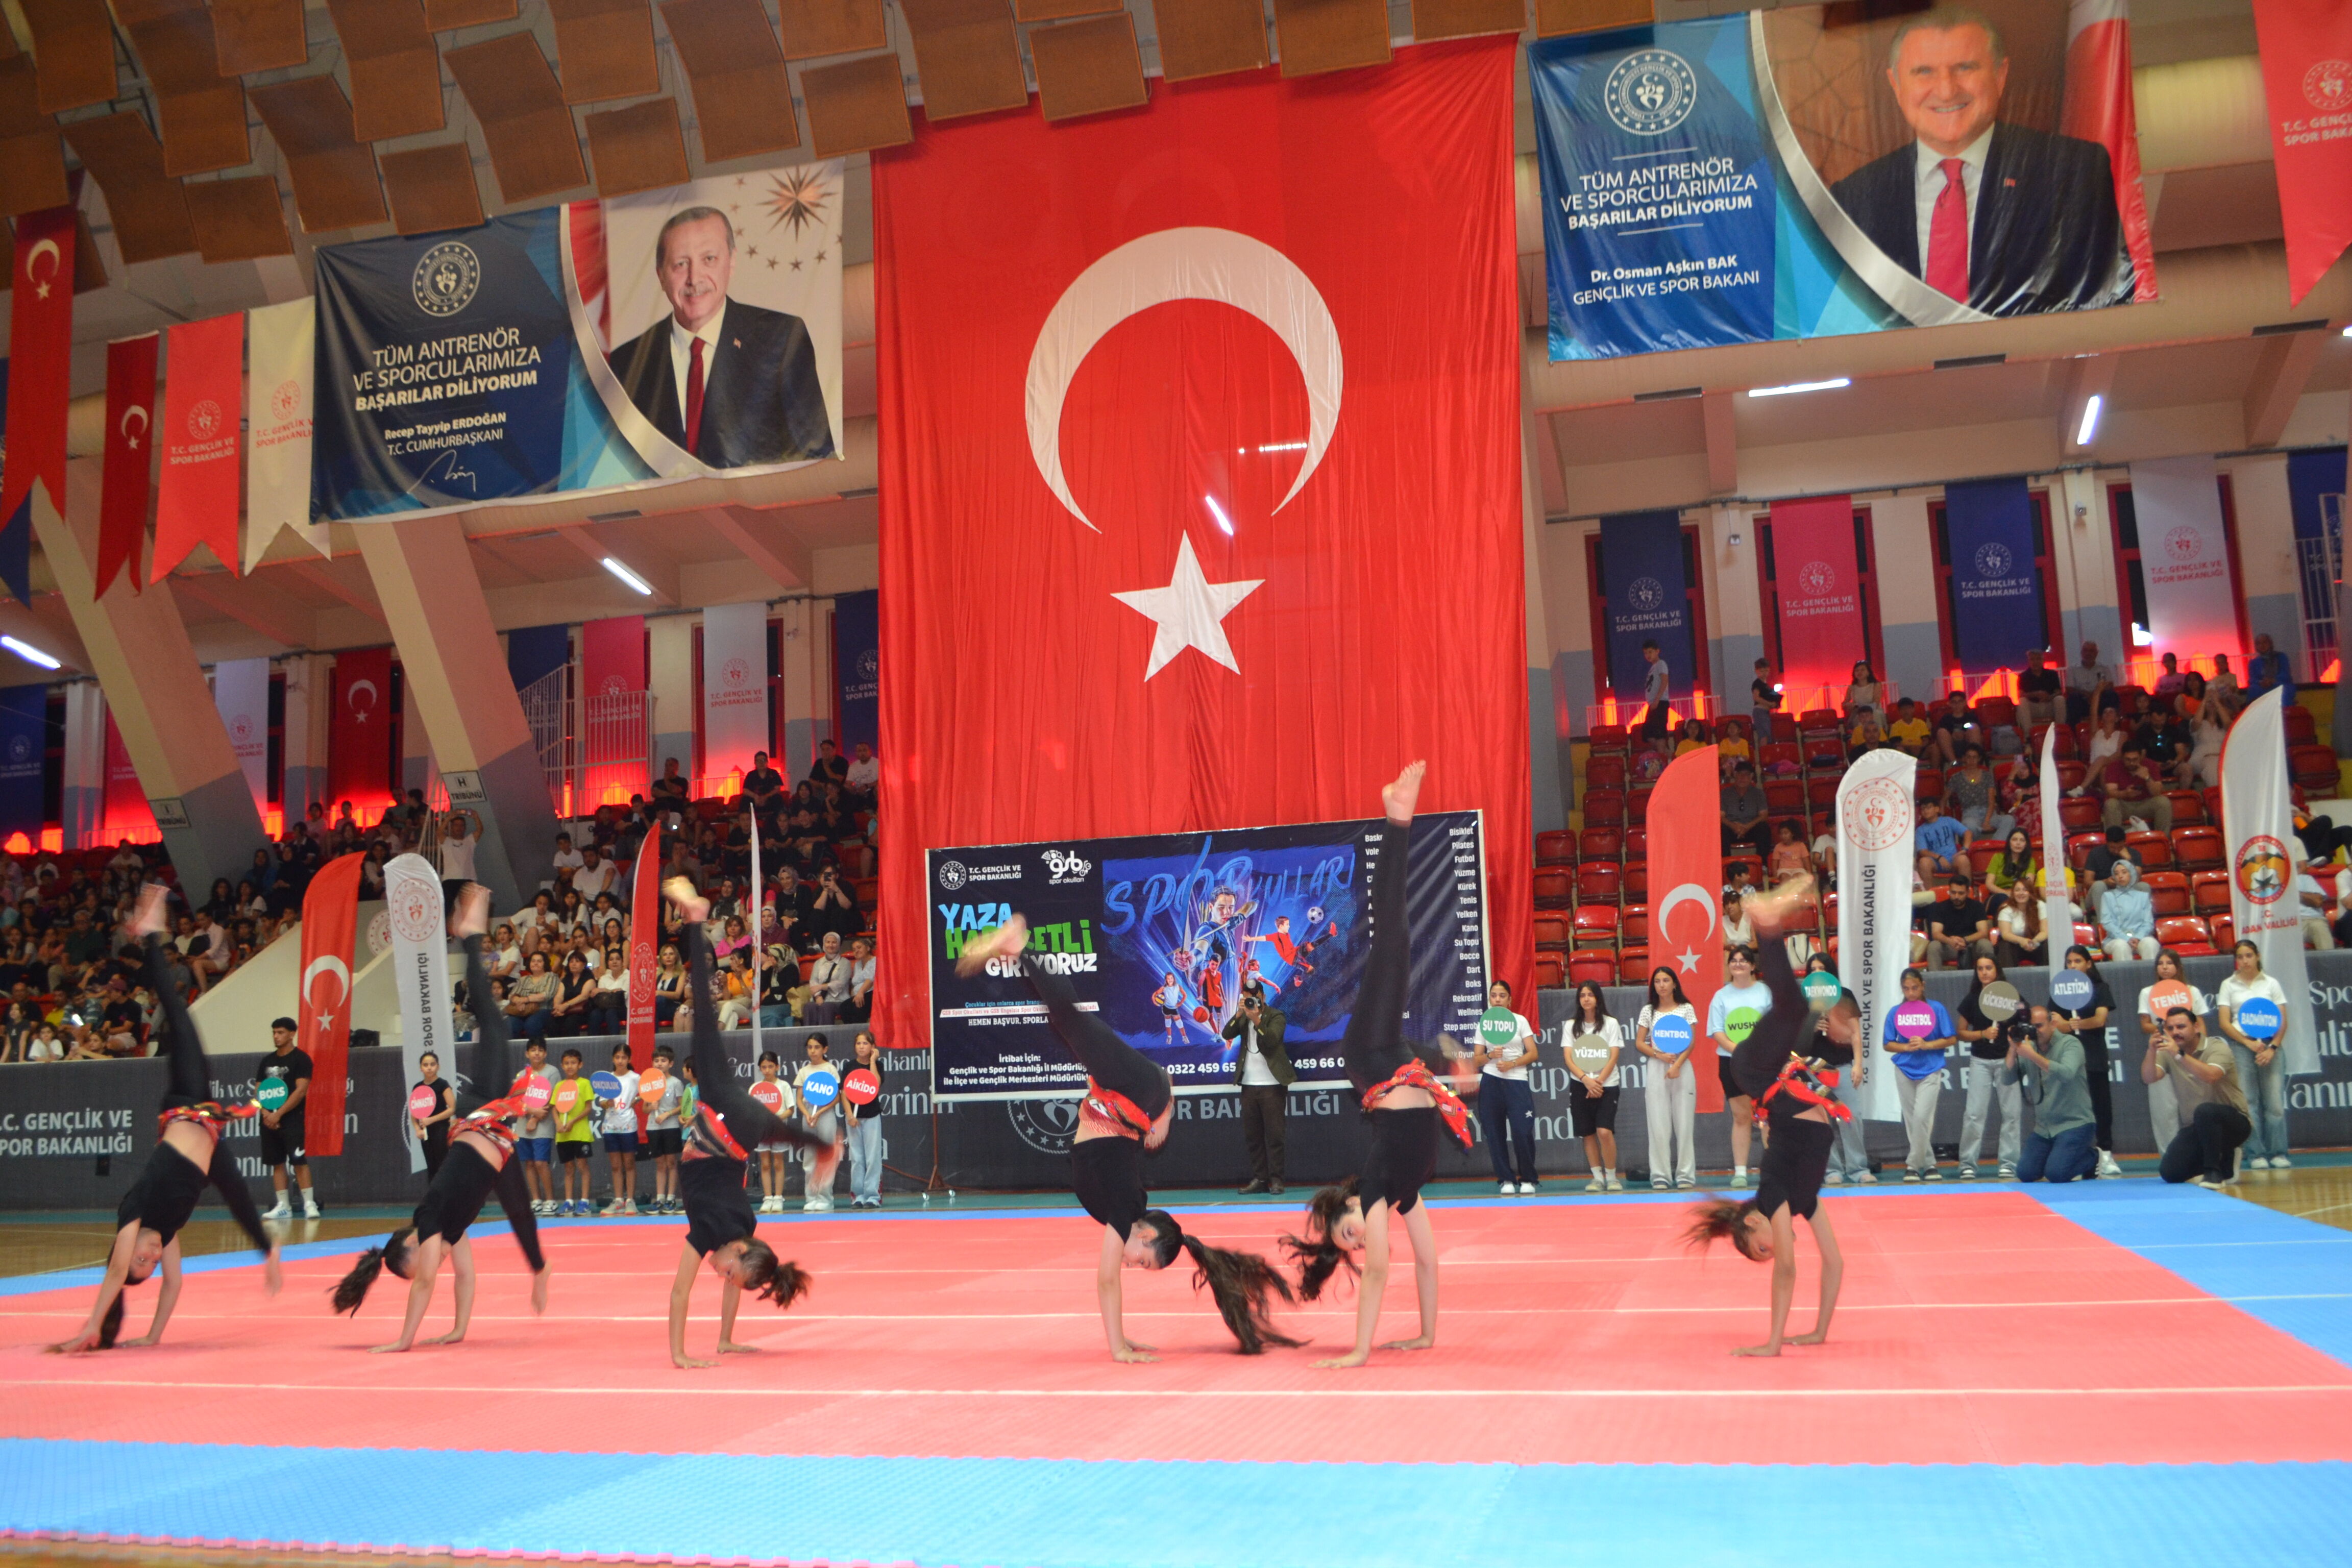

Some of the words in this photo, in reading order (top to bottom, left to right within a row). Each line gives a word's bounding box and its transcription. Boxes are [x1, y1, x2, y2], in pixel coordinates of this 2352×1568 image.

[2284, 131, 2319, 146] SPOR
[1580, 170, 1624, 192] TÜM
[1629, 156, 1734, 186] ANTRENÖR
[1560, 194, 1581, 213] VE
[1588, 174, 1758, 210] SPORCULARIMIZA
[1569, 206, 1658, 230] BAŞARILAR
[1660, 194, 1753, 219] DİLİYORUM
[1591, 269, 1611, 283] Dr.
[1613, 264, 1662, 280] Osman
[1665, 258, 1704, 276] Aşkın
[1707, 255, 1738, 270] BAK
[1573, 282, 1635, 306] GENÇLİK
[1637, 281, 1656, 297] VE
[1659, 277, 1699, 295] SPOR
[1703, 271, 1760, 289] BAKANI
[373, 344, 413, 368] TÜM
[418, 327, 520, 359] ANTRENÖR
[354, 369, 373, 391] VE
[378, 346, 541, 388] SPORCULARIMIZA
[356, 382, 444, 412] BAŞARILAR
[446, 370, 537, 399] DİLİYORUM
[385, 428, 414, 441] Recep
[416, 422, 451, 437] Tayyip
[452, 412, 506, 430] ERDOĞAN
[170, 446, 187, 455] T.C.
[188, 439, 223, 455] GENÇLİK
[224, 437, 235, 447] VE
[387, 444, 405, 456] T.C.
[406, 428, 503, 453] CUMHURBAŞKANI
[170, 454, 193, 465] SPOR
[2169, 562, 2209, 574] GENÇLİK
[2152, 575, 2175, 583] SPOR
[2177, 569, 2223, 581] BAKANLIĞI
[1979, 578, 2016, 590] GENÇLİK
[2019, 577, 2029, 585] VE
[1962, 590, 1984, 598] SPOR
[1986, 586, 2031, 597] BAKANLIĞI
[1803, 597, 1840, 607] GENÇLİK
[1809, 604, 1854, 615] BAKANLIĞI
[1632, 612, 1668, 623] GENÇLİK
[1616, 624, 1637, 632] SPOR
[1639, 619, 1681, 630] BAKANLIĞI
[723, 689, 750, 699] GENÇLİK
[457, 778, 467, 787] H
[1449, 827, 1474, 837] Bisiklet
[1452, 841, 1475, 850] Pilates
[1455, 854, 1475, 863] Futbol
[982, 865, 1011, 873] GENÇLİK
[1454, 869, 1476, 877] Yüzme
[987, 872, 1021, 880] BAKANLIĞI
[1458, 882, 1477, 891] Kürek
[1460, 896, 1477, 904] Tenis
[1861, 864, 1876, 935] BAKANLIĞI
[938, 903, 1015, 934] YAZA
[1456, 910, 1478, 919] Yelken
[1462, 924, 1478, 933] Kano
[1454, 938, 1462, 946] Su
[1463, 938, 1479, 948] Topu
[1459, 952, 1480, 961] Bocce
[1863, 940, 1874, 975] SPOR
[1466, 966, 1481, 974] Dart
[1804, 985, 1837, 997] TAEKWONDO
[1863, 978, 1872, 996] VE
[2054, 978, 2090, 995] ATLETİZM
[1453, 993, 1482, 1002] Rekreatif
[2151, 990, 2188, 1009] TENİS
[968, 1018, 991, 1026] HEMEN
[1897, 1014, 1931, 1025] BASKETBOL
[2241, 1010, 2277, 1027] BADMİNTON
[1443, 1023, 1458, 1032] Step
[1483, 1020, 1493, 1031] SU
[1494, 1021, 1514, 1032] TOPU
[1728, 1021, 1758, 1031] WUSH
[1862, 999, 1872, 1059] GENÇLİK
[1654, 1028, 1689, 1039] HENTBOL
[999, 1054, 1023, 1063] İrtibat
[1575, 1047, 1607, 1058] YÜZME
[949, 1066, 977, 1075] Gençlik
[989, 1066, 1007, 1075] Spor
[1008, 1064, 1043, 1073] Bakanlığı
[1167, 1064, 1195, 1074] 0322
[1198, 1063, 1220, 1073] 459
[1222, 1062, 1236, 1072] 65
[1294, 1059, 1317, 1069] 459
[1319, 1058, 1335, 1068] 66
[846, 1078, 876, 1094] AİKİDO
[954, 1076, 968, 1086] İlçe
[979, 1075, 1007, 1086] Gençlik
[1009, 1075, 1048, 1083] Merkezleri
[259, 1087, 285, 1100] BOKS
[640, 1083, 651, 1093] MASA
[805, 1081, 834, 1096] KANO
[24, 1108, 104, 1134] GENÇLİK
[109, 1110, 132, 1128] VE
[0, 1139, 33, 1156] POR
[37, 1132, 132, 1155] BAKANLIĞI
